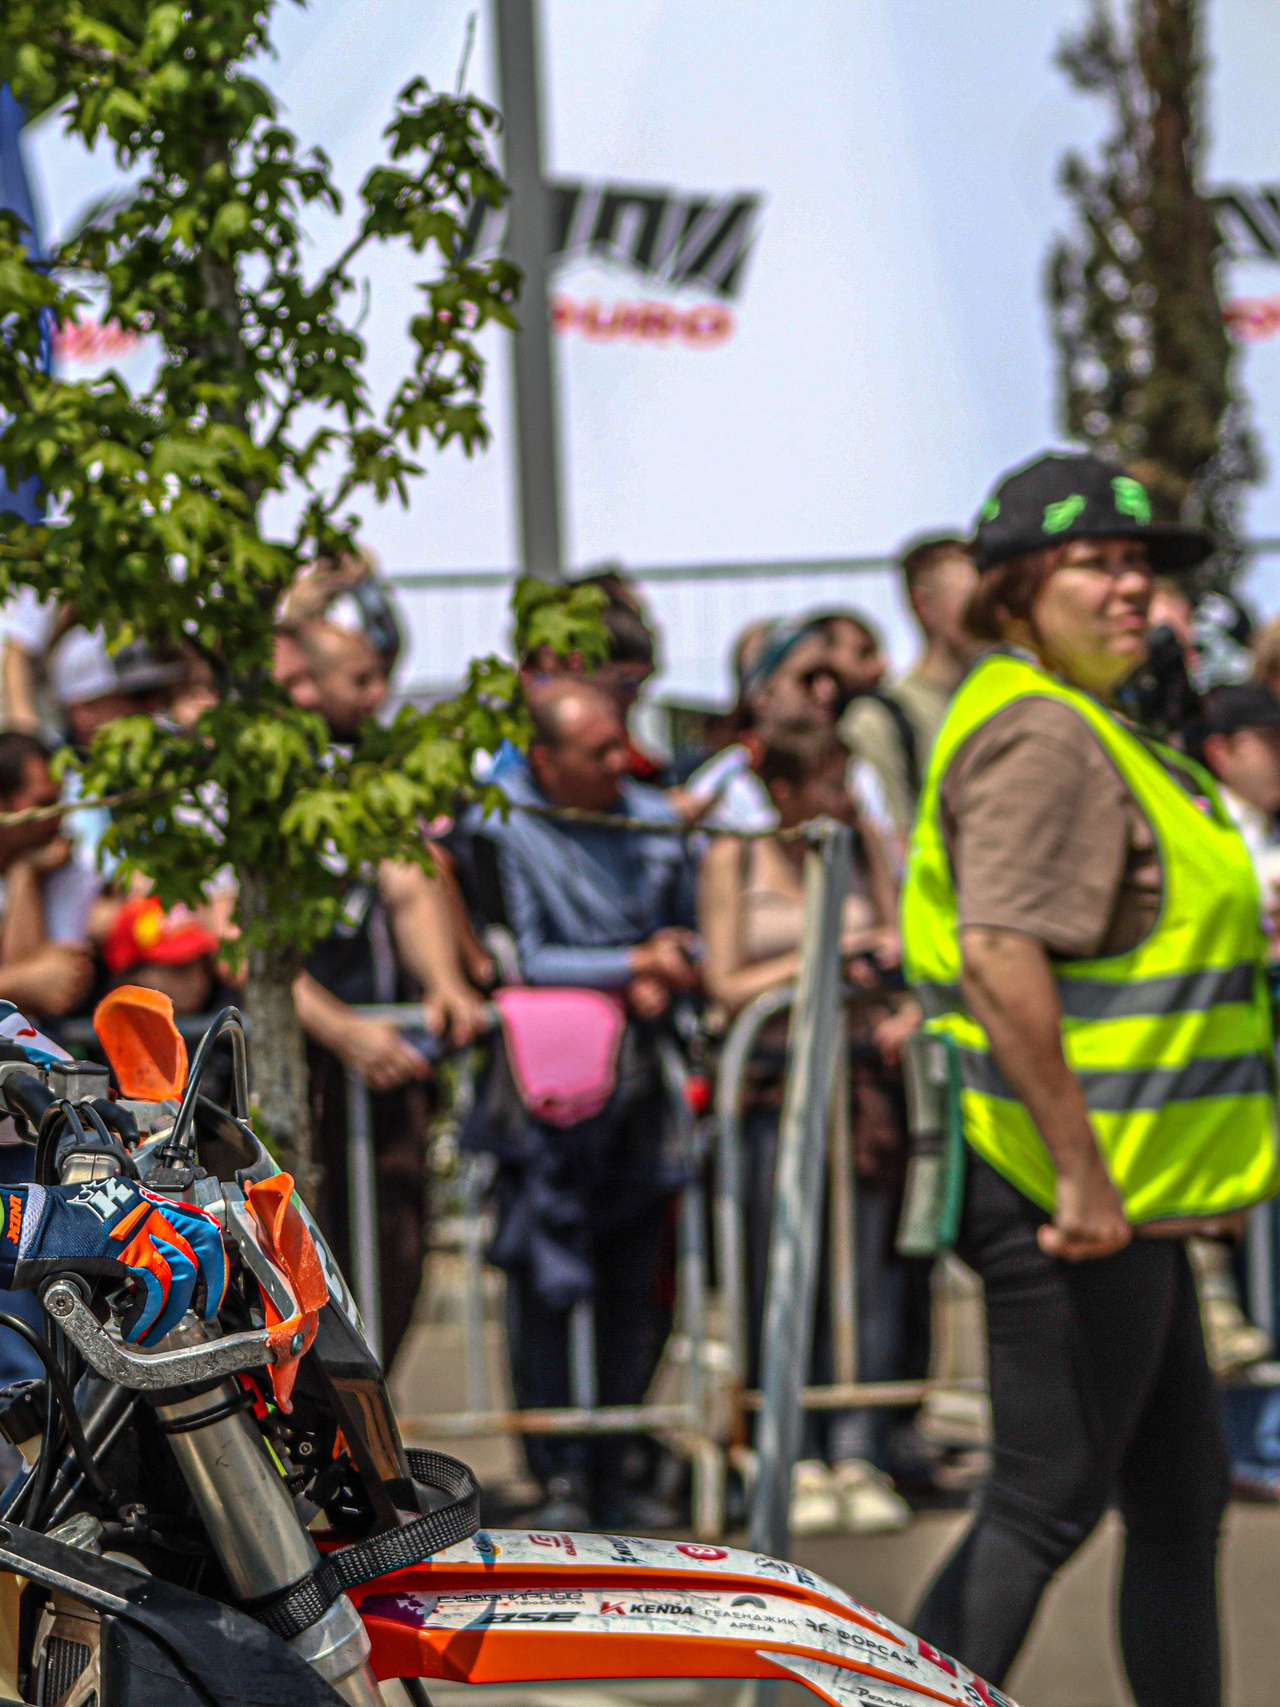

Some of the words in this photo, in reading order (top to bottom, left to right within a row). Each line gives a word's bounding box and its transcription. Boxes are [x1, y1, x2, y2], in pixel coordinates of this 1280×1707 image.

[630, 1603, 694, 1615] KENDA
[730, 1621, 775, 1633] АРЕНА
[837, 1629, 918, 1668] ФОРСАЖ
